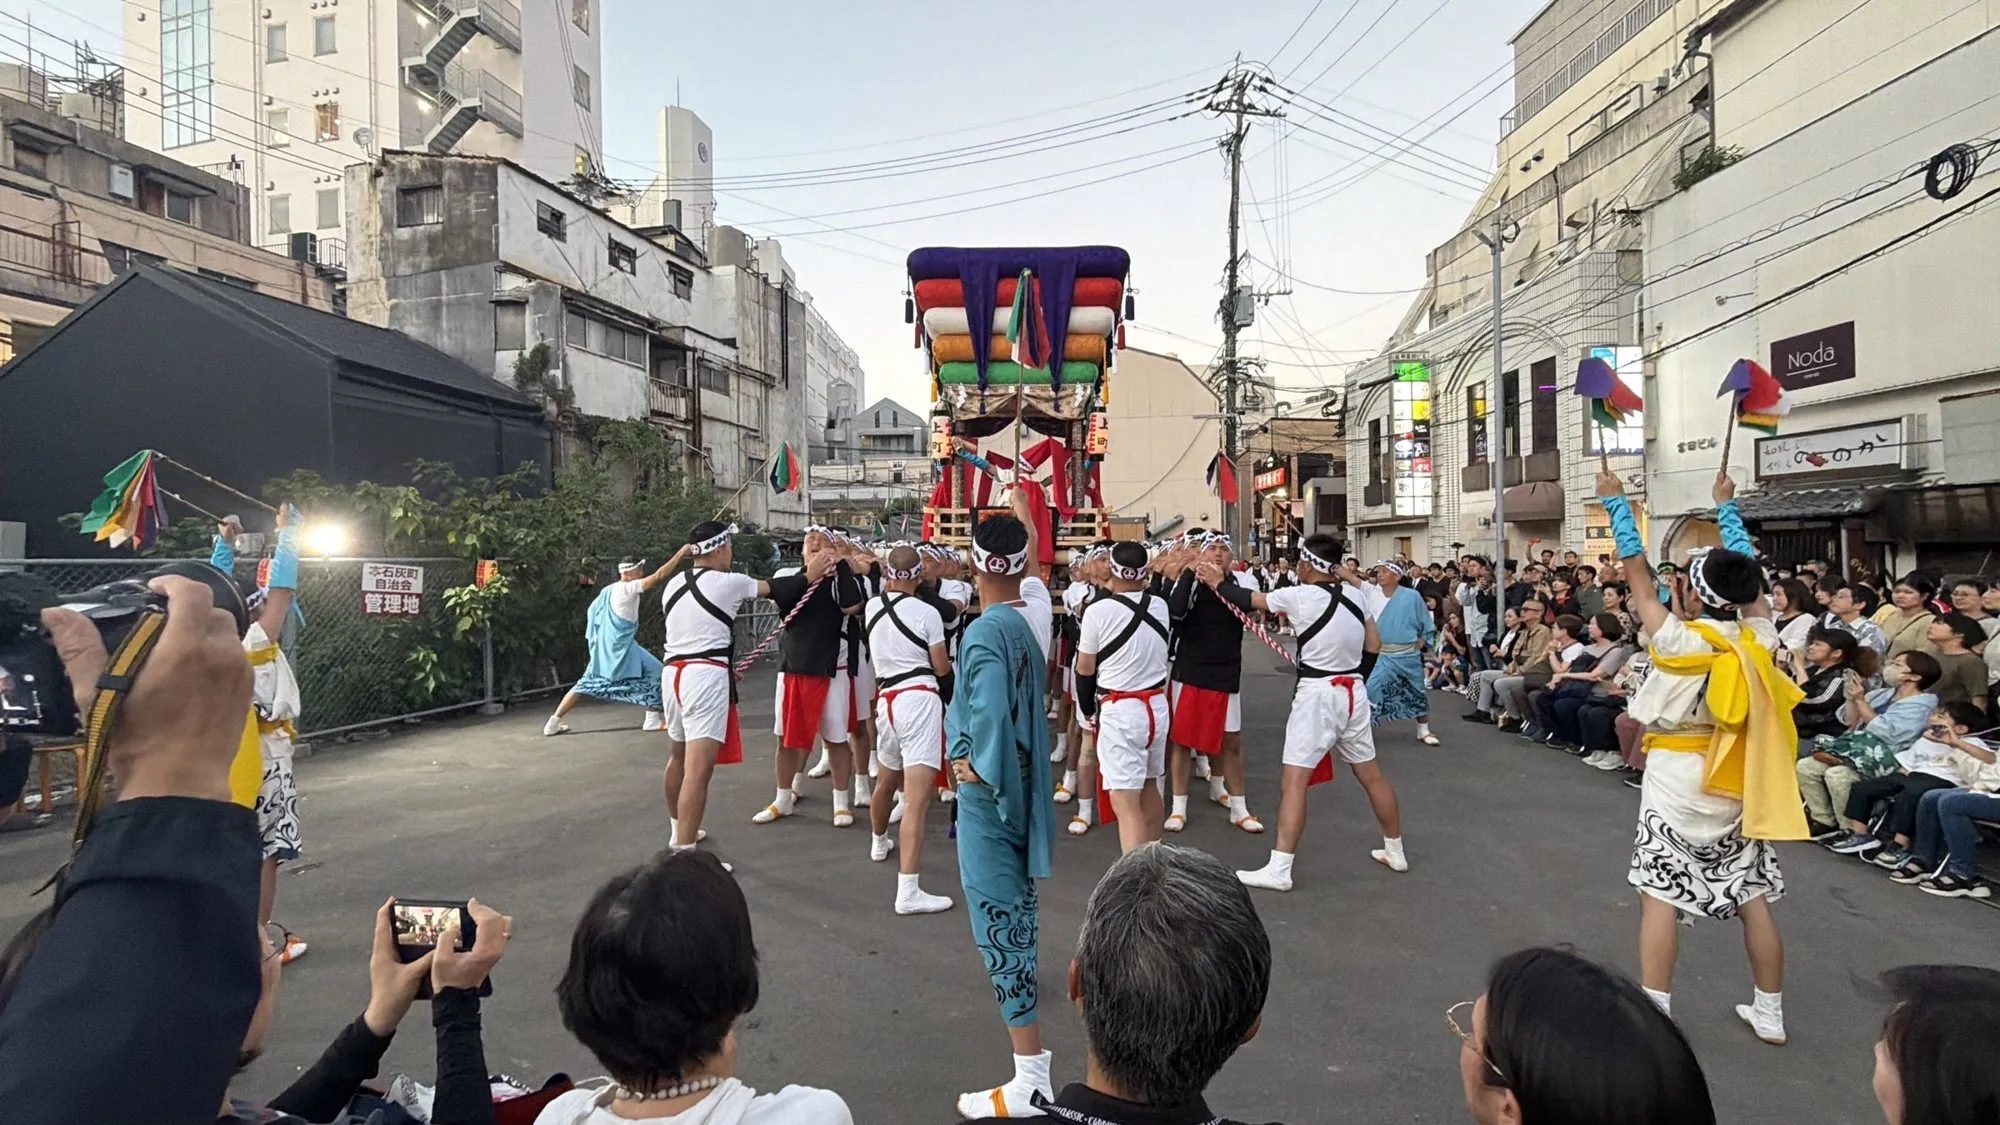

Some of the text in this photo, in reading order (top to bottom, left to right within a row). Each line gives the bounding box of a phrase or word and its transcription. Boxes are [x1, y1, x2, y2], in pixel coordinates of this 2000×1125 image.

[1788, 340, 1835, 370] Noda
[932, 421, 944, 454] 上町
[1097, 417, 1109, 450] 上町
[369, 565, 419, 579] 本石灰町
[375, 578, 412, 591] 自治会
[364, 593, 420, 614] 管理地
